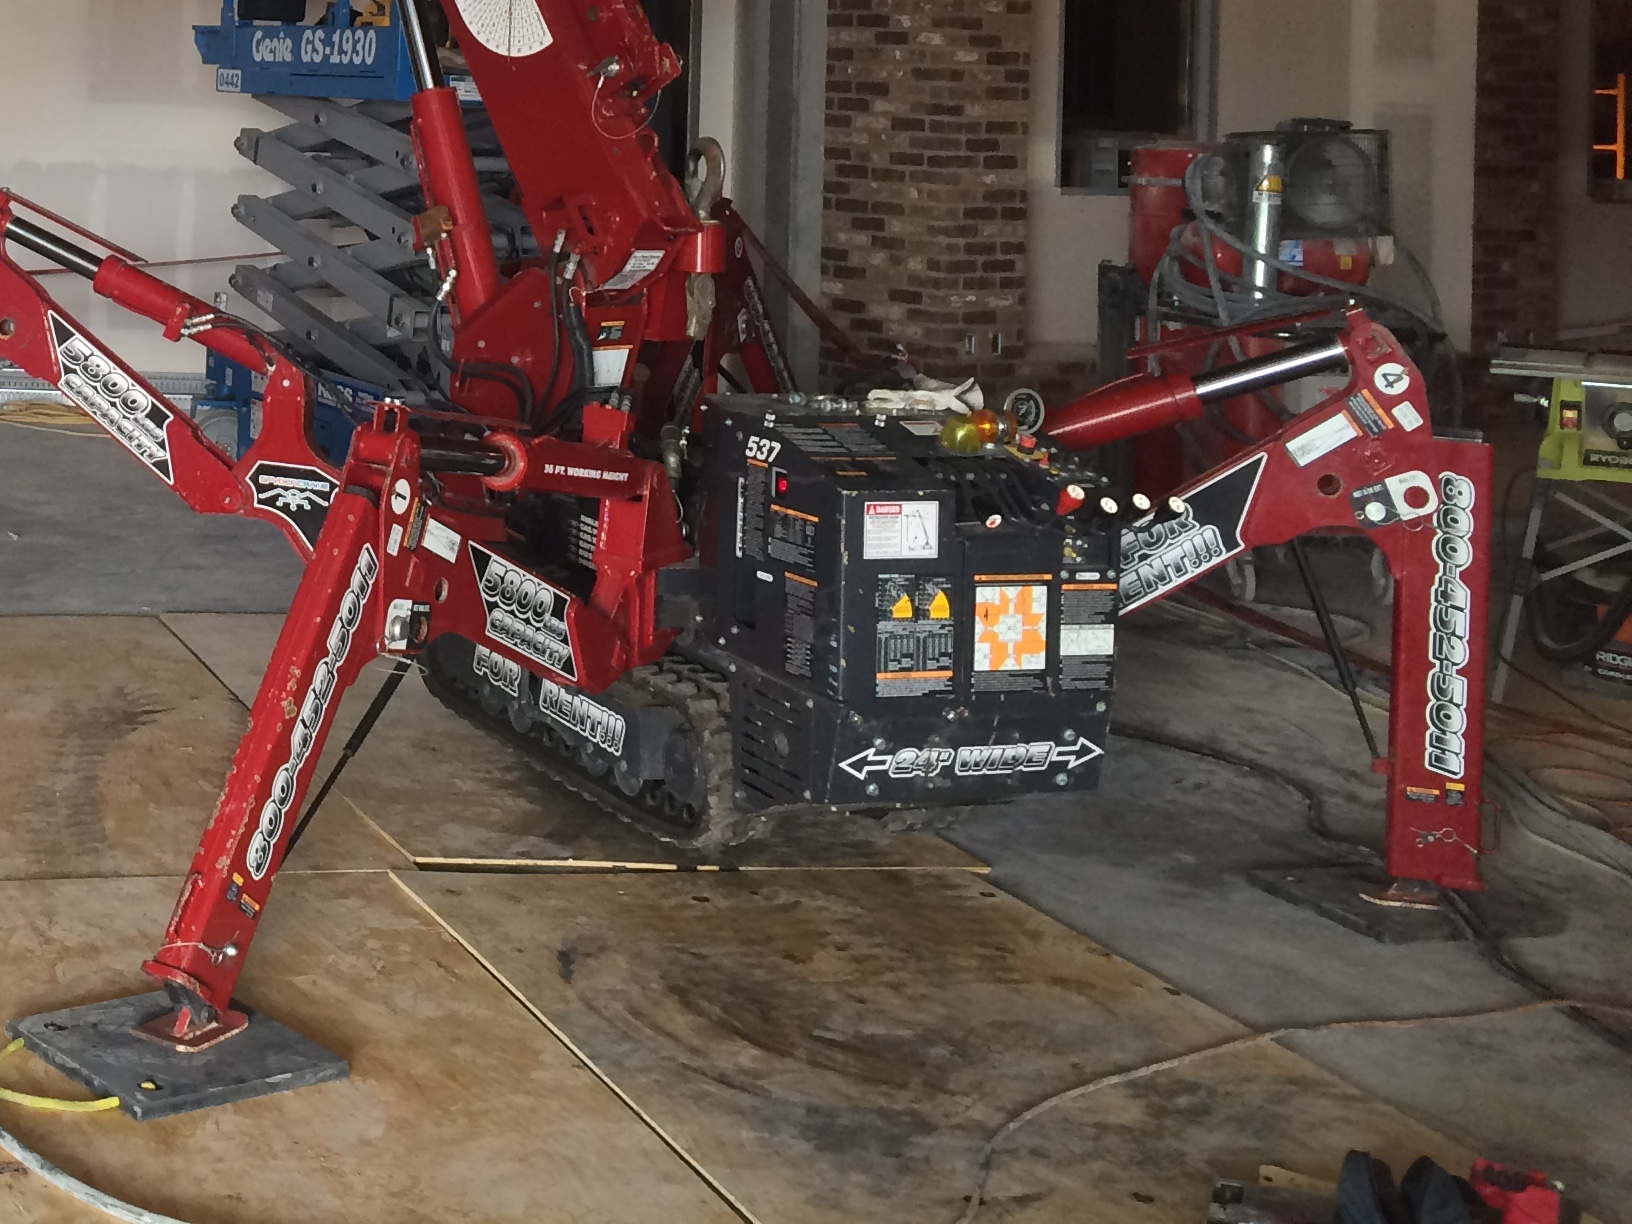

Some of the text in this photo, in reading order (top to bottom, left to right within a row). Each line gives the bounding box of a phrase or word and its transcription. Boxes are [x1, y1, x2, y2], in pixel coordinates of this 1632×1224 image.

[252, 28, 377, 66] Genie GS-1930
[218, 71, 241, 89] 0442
[59, 336, 151, 413] 5800
[1381, 372, 1405, 389] 4
[63, 373, 168, 463] CAPACITY
[567, 466, 601, 480] WORKING
[602, 470, 629, 482] HEIGHT
[745, 435, 781, 463] 537
[875, 505, 901, 514] DANGER
[482, 557, 554, 625] 5800
[1118, 525, 1226, 604] ENT!!!
[488, 607, 571, 669] CAPACITY
[1425, 471, 1475, 779] 800-452-5011
[473, 643, 521, 697] FOR
[247, 543, 378, 880] 800-452-5011
[539, 678, 625, 756] RENT!!!
[889, 741, 1056, 778] 24" WIDE
